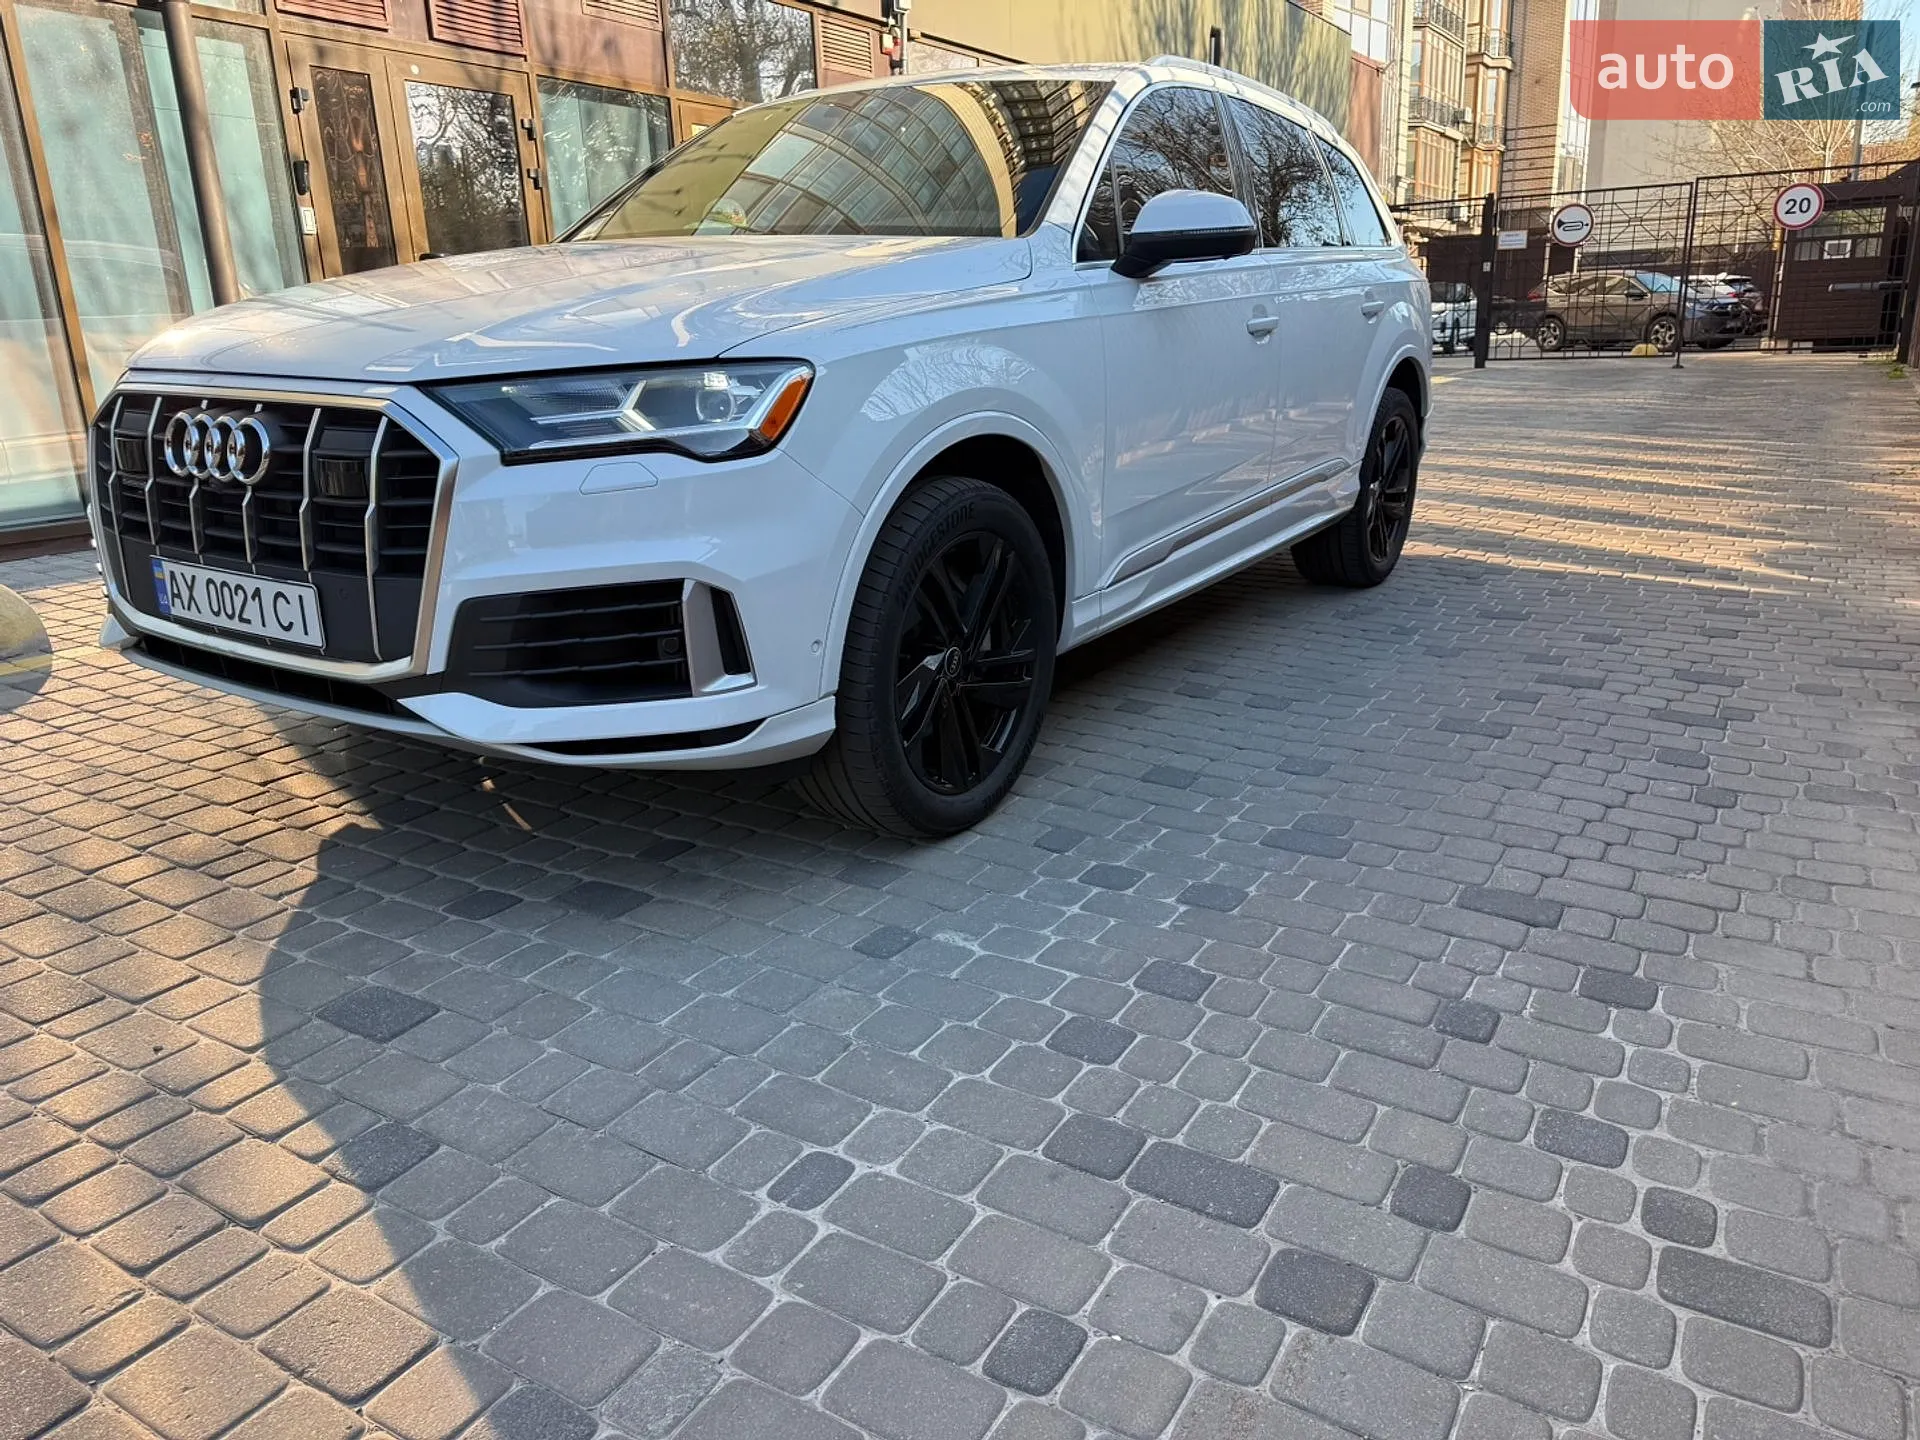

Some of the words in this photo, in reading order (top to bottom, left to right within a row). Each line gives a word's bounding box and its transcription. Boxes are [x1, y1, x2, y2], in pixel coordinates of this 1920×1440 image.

[1784, 197, 1812, 215] 20
[169, 570, 202, 614] AX
[205, 577, 266, 628] 0021
[273, 591, 309, 636] CI
